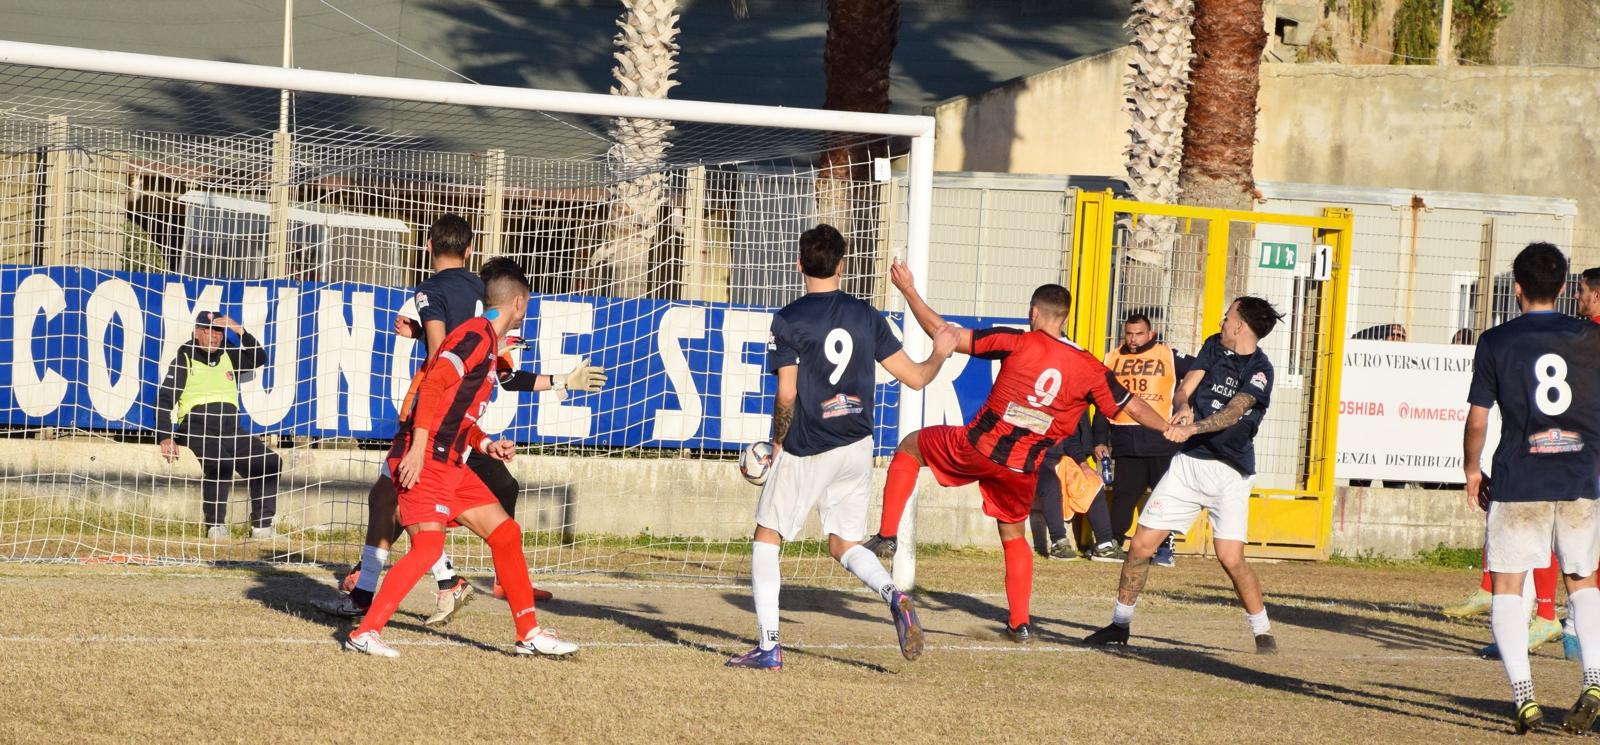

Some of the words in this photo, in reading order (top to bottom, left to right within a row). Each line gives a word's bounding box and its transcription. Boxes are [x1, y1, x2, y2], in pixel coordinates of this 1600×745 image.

[1321, 248, 1327, 277] 1
[824, 328, 853, 386] 9
[1113, 358, 1165, 377] LEGEA
[1385, 354, 1439, 371] VERSACI
[1027, 368, 1063, 408] 9
[1122, 378, 1148, 392] 318
[1535, 353, 1572, 416] 8
